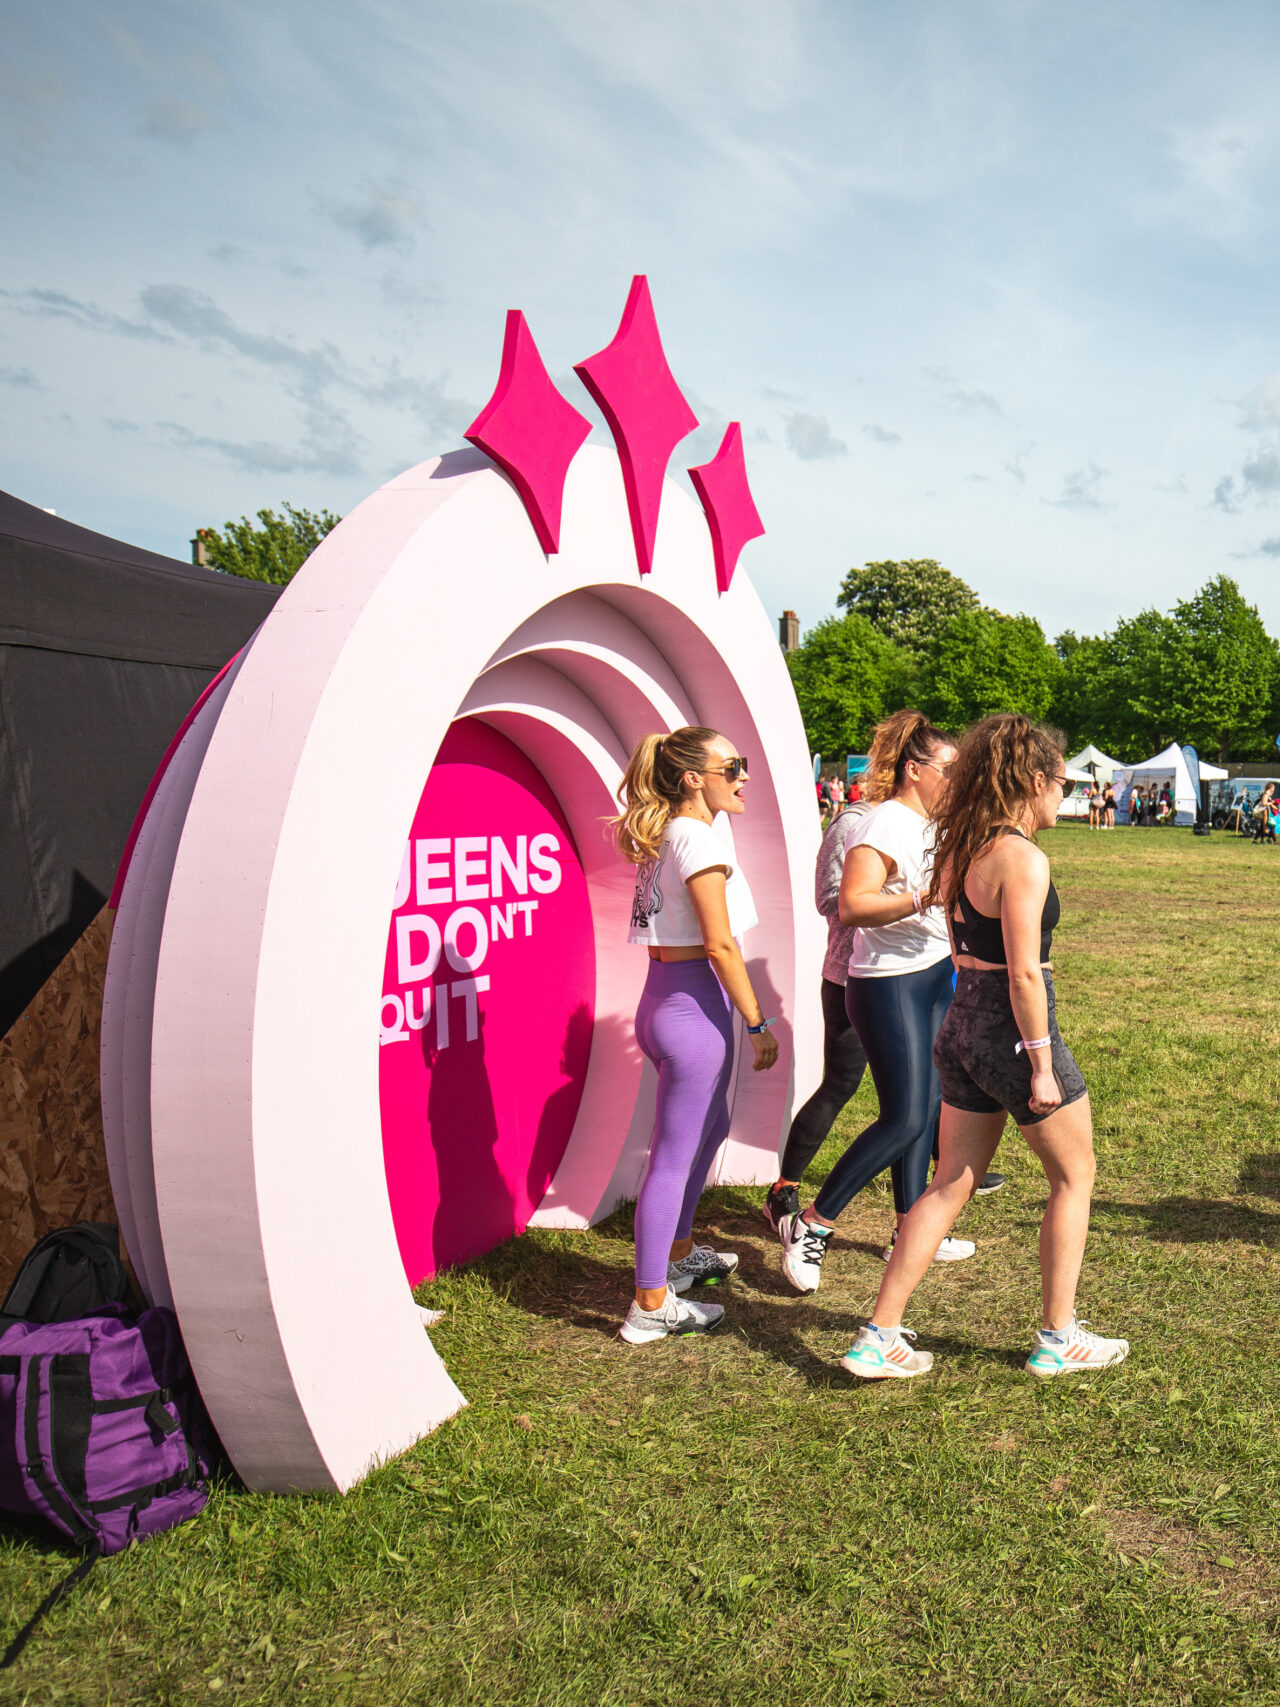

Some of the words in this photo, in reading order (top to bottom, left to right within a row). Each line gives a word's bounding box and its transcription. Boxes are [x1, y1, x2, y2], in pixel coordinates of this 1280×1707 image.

[392, 832, 562, 911] EENS
[395, 900, 539, 984] DON'T
[379, 975, 490, 1050] QUIT
